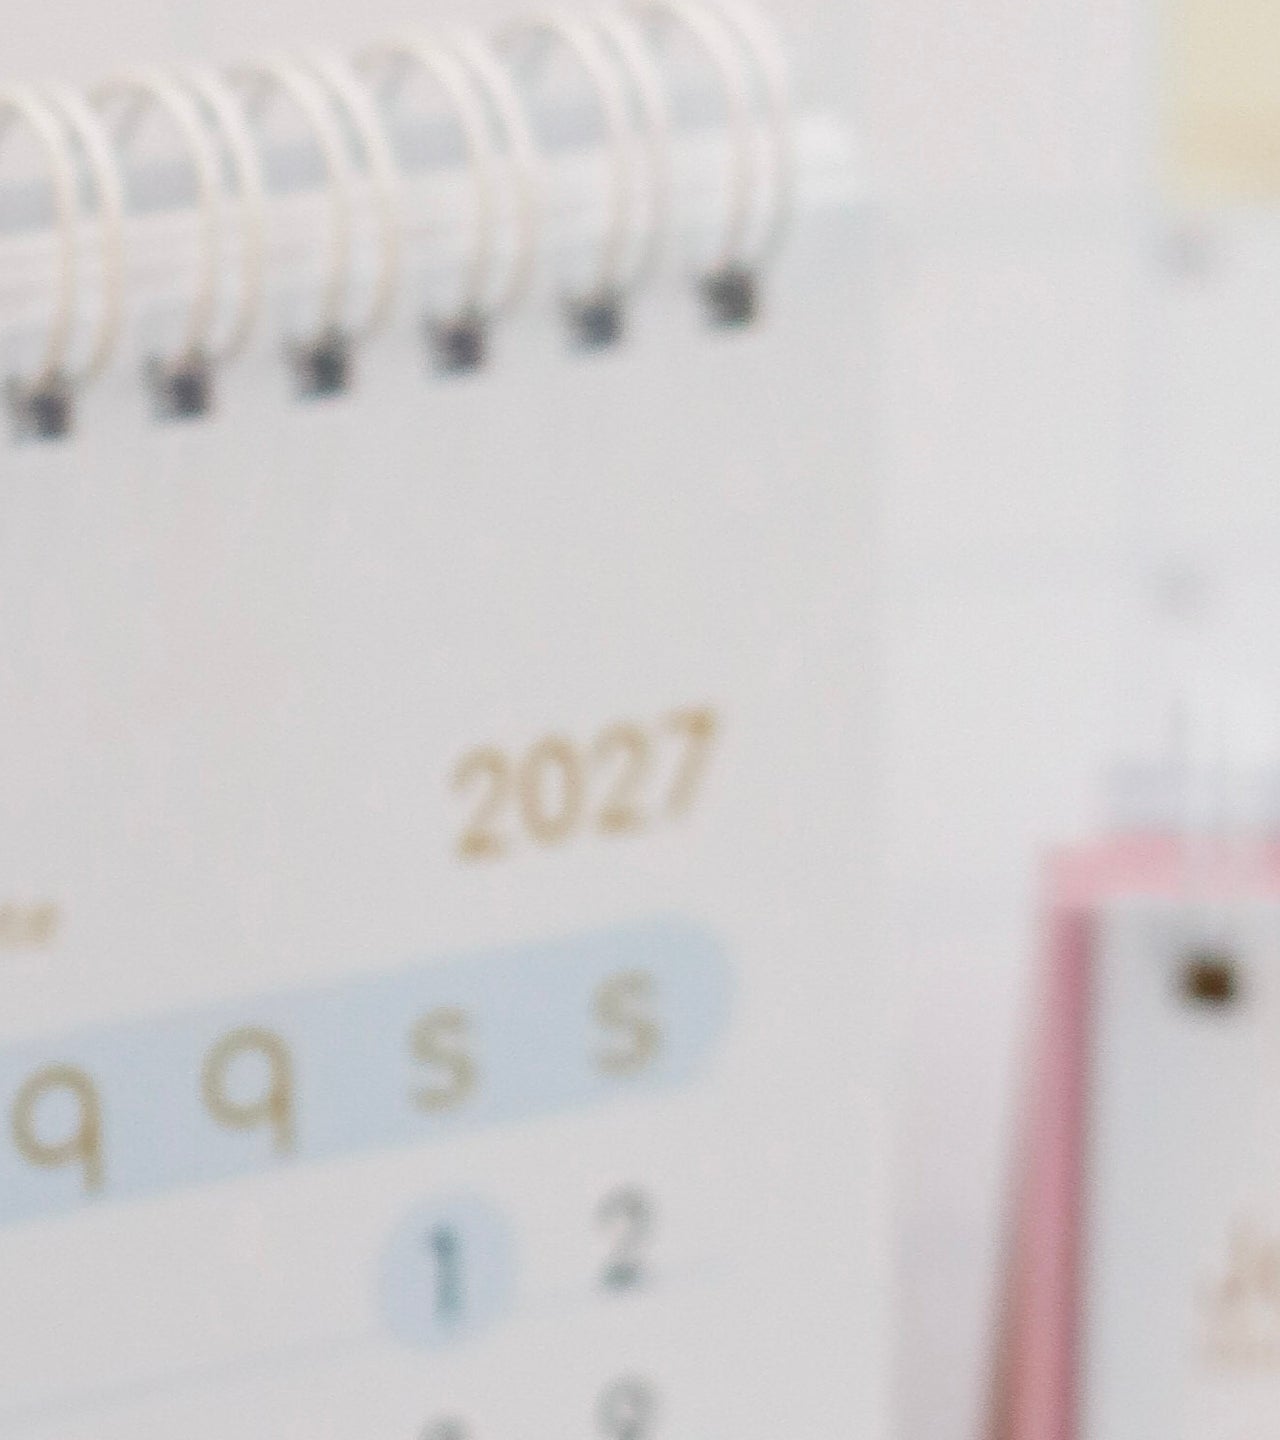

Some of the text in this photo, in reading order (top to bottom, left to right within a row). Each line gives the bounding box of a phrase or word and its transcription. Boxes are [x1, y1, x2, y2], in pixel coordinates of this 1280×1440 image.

[451, 706, 721, 866] 2027
[7, 1060, 108, 1196] q
[198, 1024, 301, 1157] q
[405, 1003, 482, 1114] s
[588, 967, 666, 1079] s
[425, 1188, 656, 1322] 1 2
